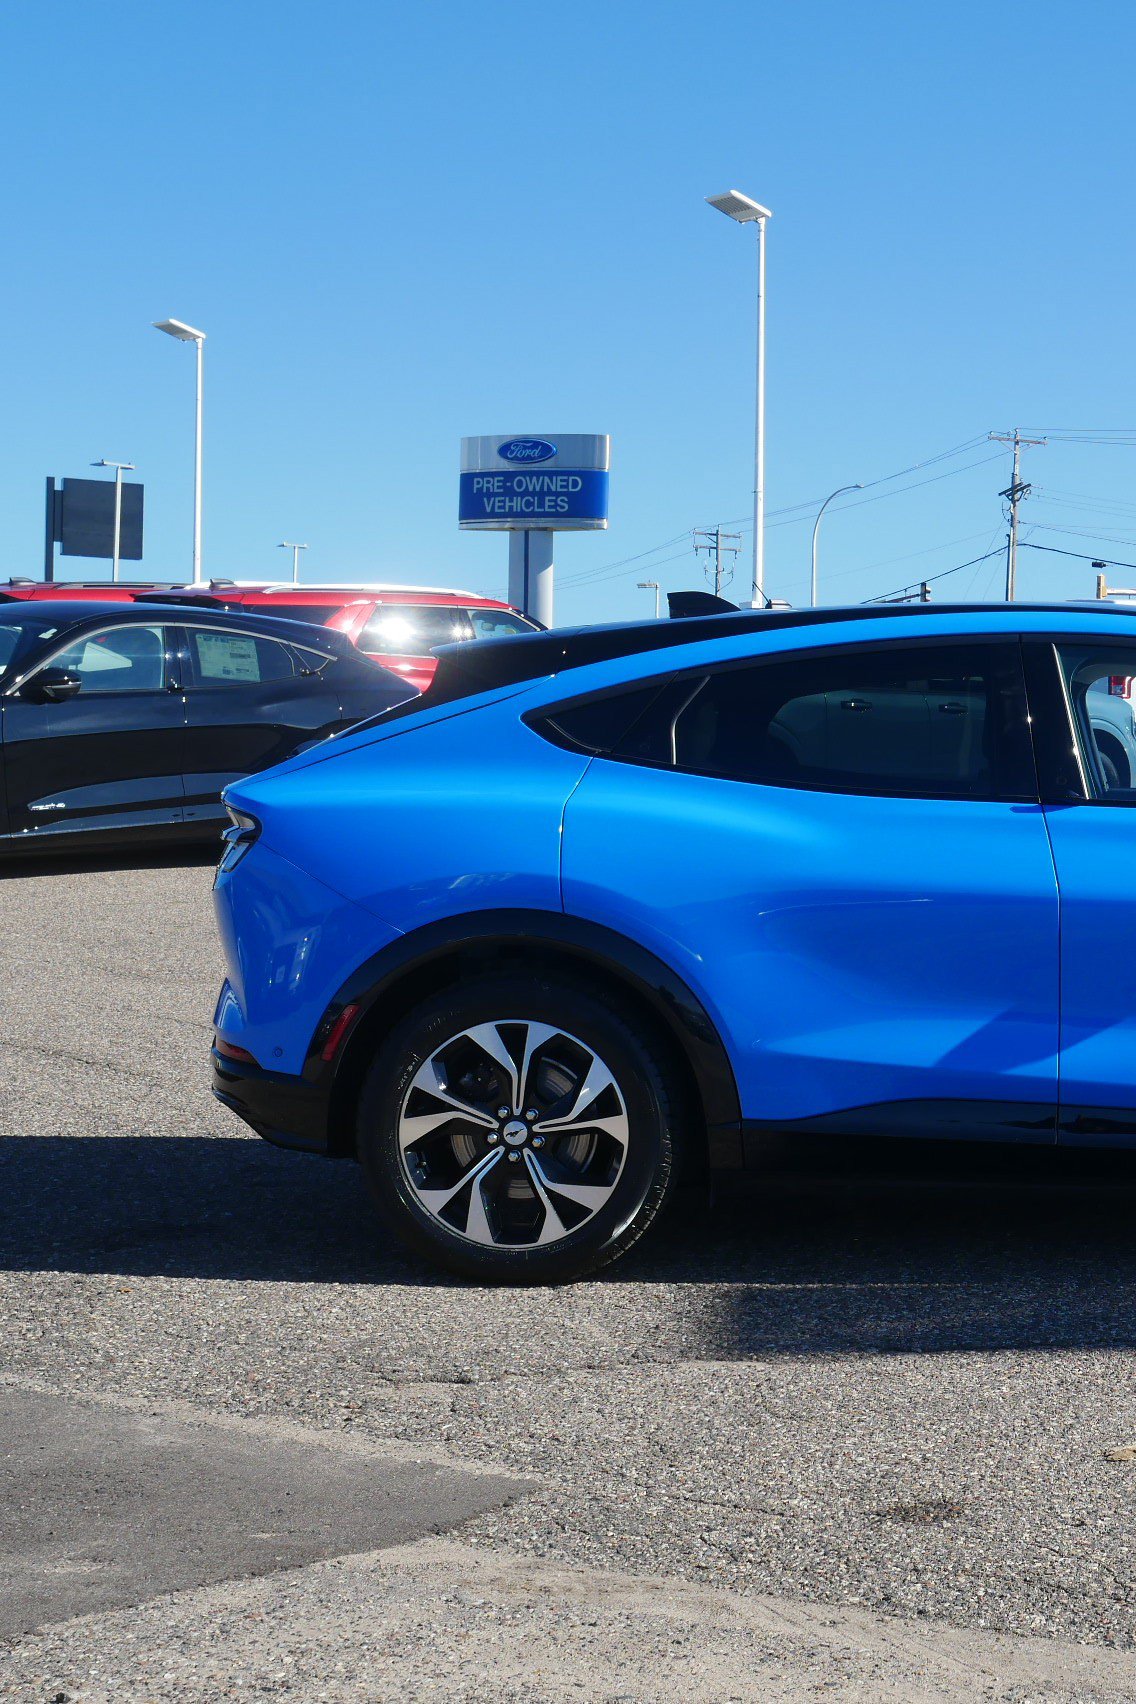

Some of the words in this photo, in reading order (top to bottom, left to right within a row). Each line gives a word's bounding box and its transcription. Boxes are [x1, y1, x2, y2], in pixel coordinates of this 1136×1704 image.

[507, 442, 542, 458] Ford
[473, 476, 583, 494] PRE-OWNED
[483, 497, 569, 512] VEHICLES
